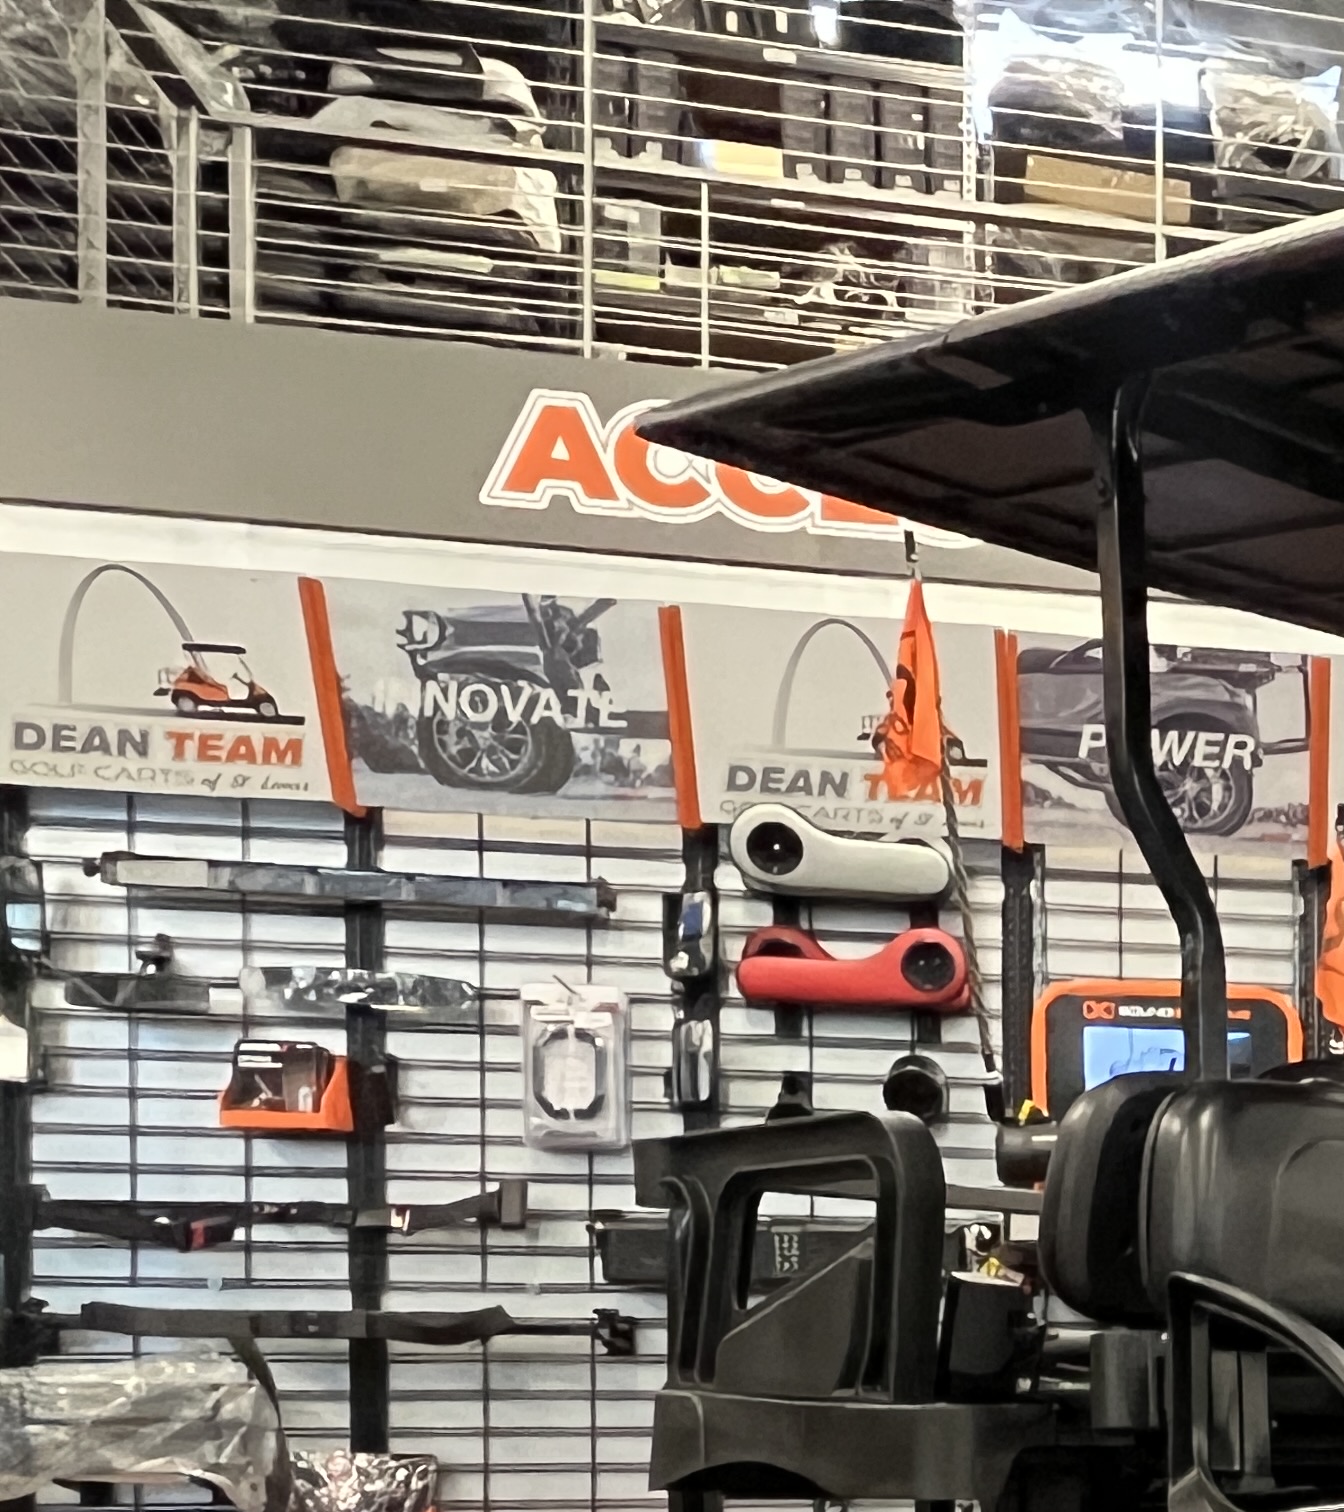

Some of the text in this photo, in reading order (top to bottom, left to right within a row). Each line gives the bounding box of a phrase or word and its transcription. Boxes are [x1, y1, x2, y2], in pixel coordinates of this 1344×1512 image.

[13, 720, 304, 767] DEAN TEAM
[1078, 723, 1256, 771] PWER
[725, 764, 849, 798] DEAN
